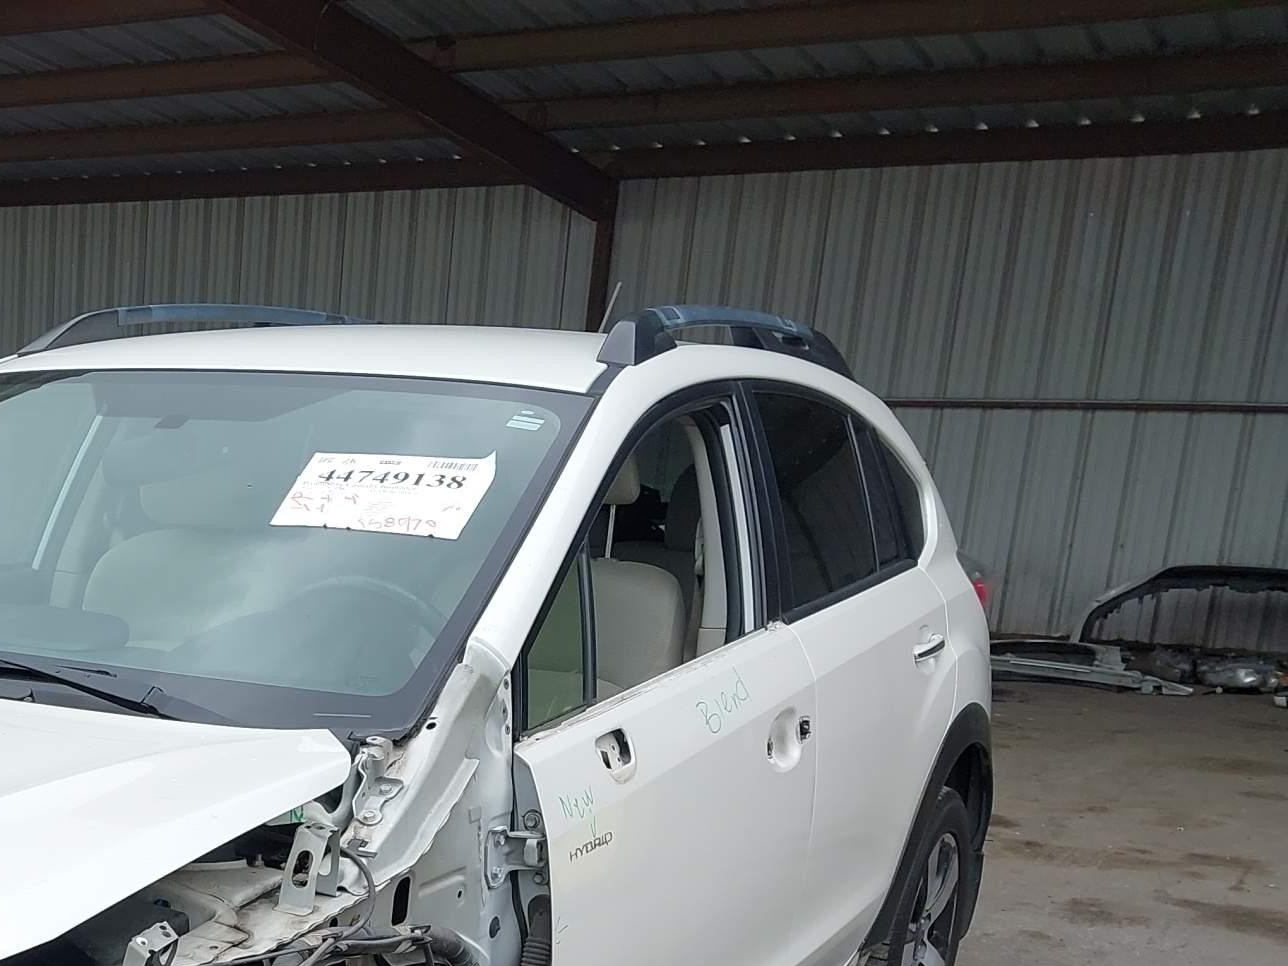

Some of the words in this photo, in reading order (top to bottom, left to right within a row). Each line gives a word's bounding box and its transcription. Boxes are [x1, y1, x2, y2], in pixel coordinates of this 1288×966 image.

[318, 469, 466, 489] 44749138
[558, 784, 594, 818] New
[569, 831, 613, 862] HYBRID
